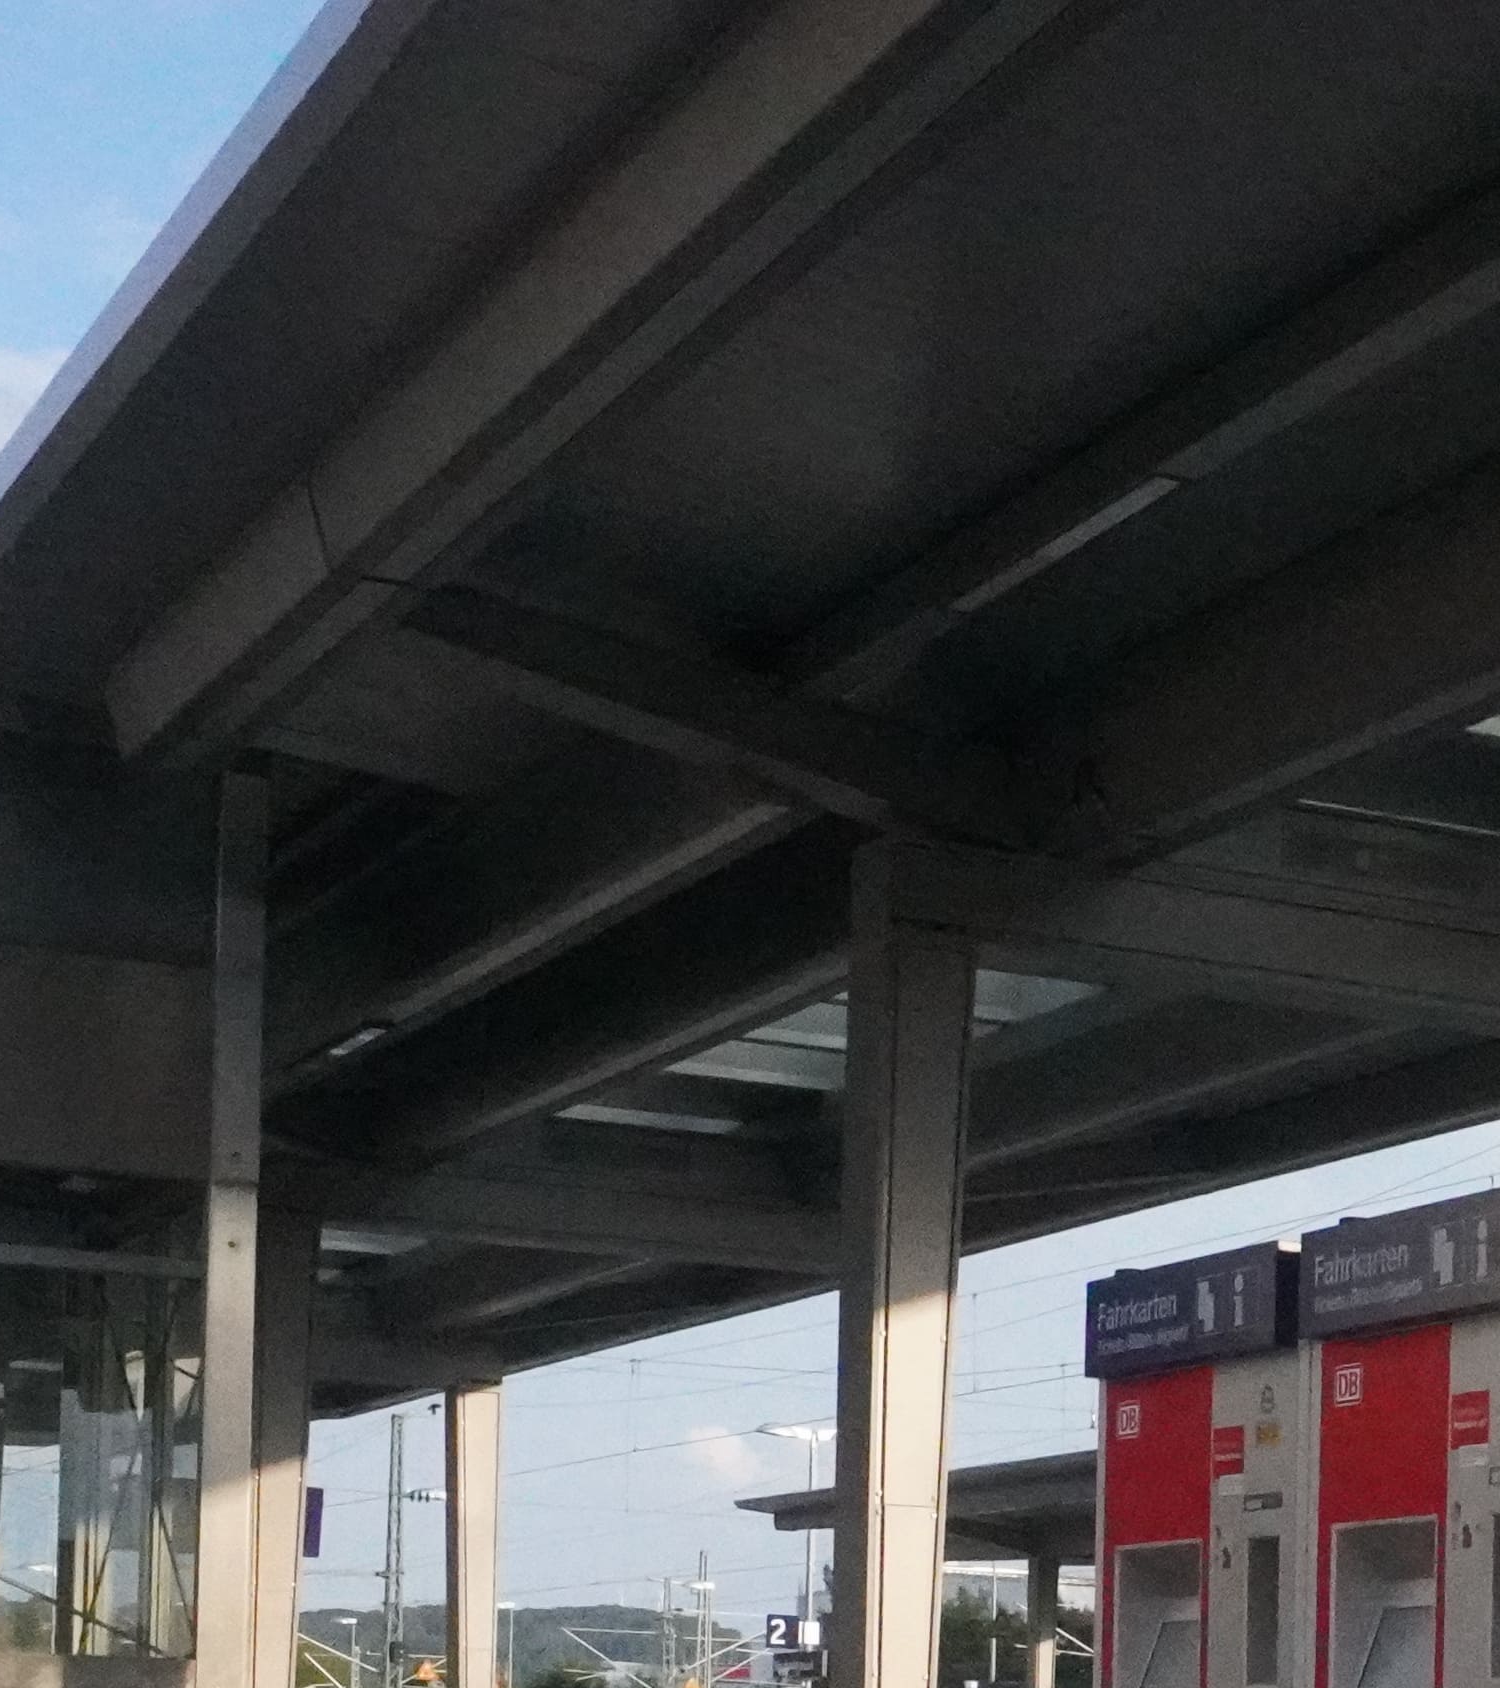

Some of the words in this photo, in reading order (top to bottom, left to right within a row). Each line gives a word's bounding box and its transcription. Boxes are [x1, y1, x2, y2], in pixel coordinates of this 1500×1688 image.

[1314, 1242, 1410, 1288] Fahrkarten
[1096, 1292, 1178, 1332] Fahrkarten
[1337, 1370, 1360, 1398] DB
[1118, 1406, 1140, 1432] DB
[769, 1617, 787, 1645] 2
